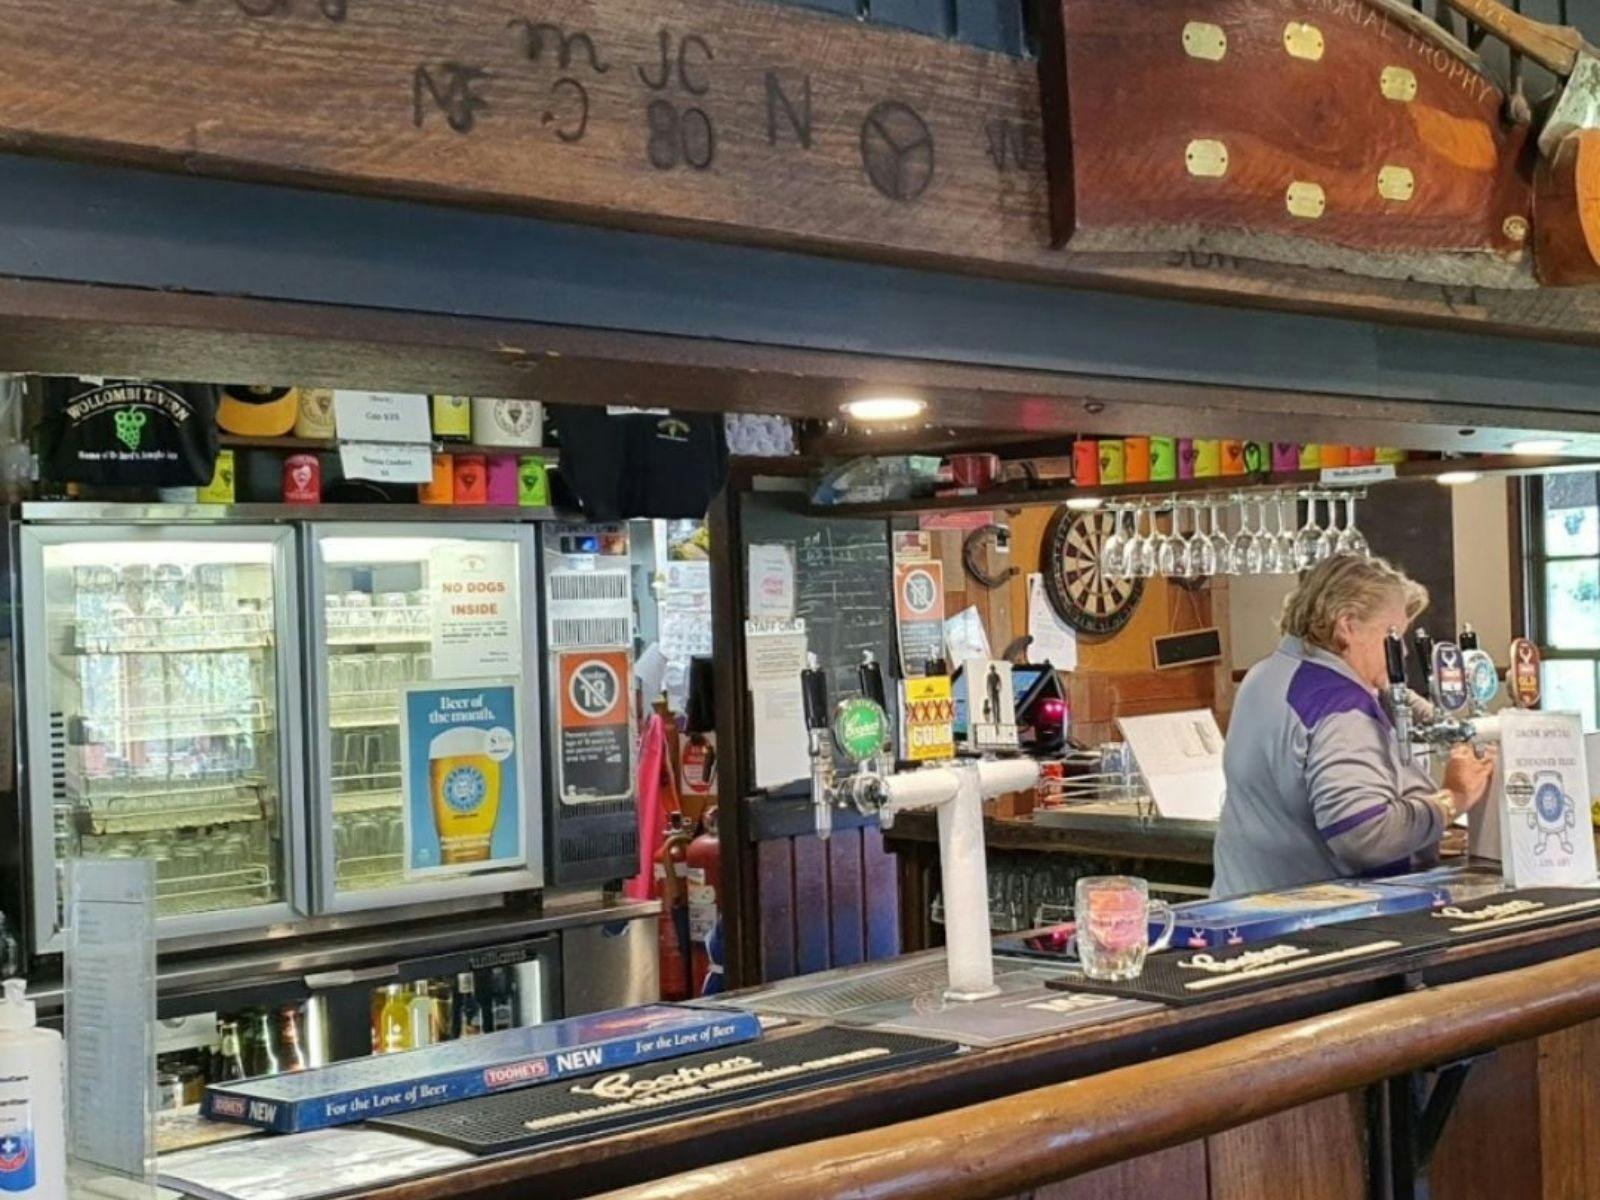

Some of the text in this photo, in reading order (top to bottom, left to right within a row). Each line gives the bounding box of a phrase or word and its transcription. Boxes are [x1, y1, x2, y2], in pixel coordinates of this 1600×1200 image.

[1408, 35, 1492, 103] TROPHY
[66, 387, 141, 420] WOLLOMBI
[442, 581, 506, 593] NO DOGS
[451, 603, 498, 616] INSIDE
[440, 694, 483, 710] Beer of
[906, 699, 955, 723] XXXX
[428, 711, 449, 724] the
[325, 1024, 736, 1117] For the Love of Beer TOOHEYS NEW For the Love of Beer
[249, 1101, 278, 1123] NEW
